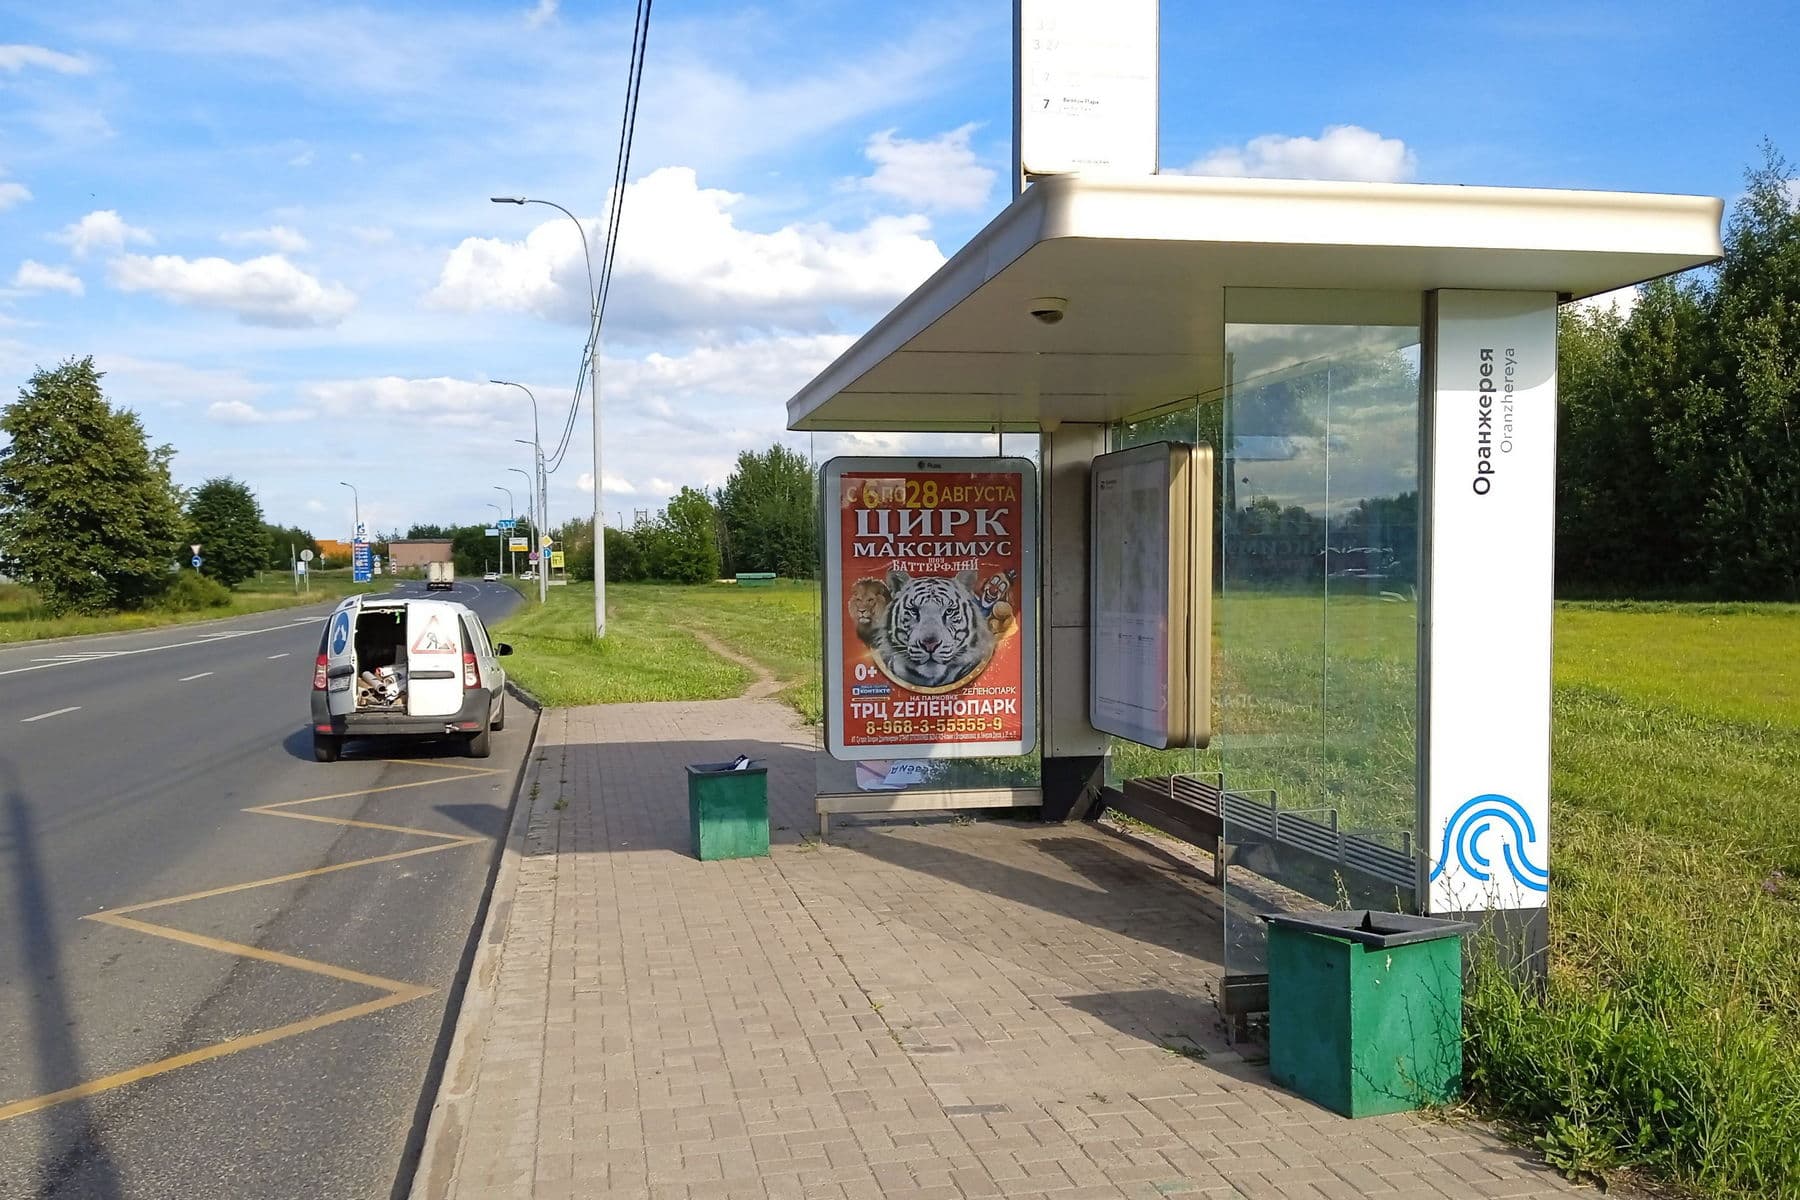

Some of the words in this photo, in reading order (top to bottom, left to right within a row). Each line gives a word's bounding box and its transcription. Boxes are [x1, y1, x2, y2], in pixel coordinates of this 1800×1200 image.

[1500, 347, 1517, 453] Oranzhereya
[1473, 348, 1496, 495] Оранжерея
[906, 480, 939, 509] 28
[940, 486, 1016, 503] АВГУСТА
[855, 508, 1009, 543] ЦИРК
[853, 541, 1012, 557] МАКСИМУС
[854, 663, 878, 681] 0+
[922, 694, 959, 702] ПАРКОВКЕ
[850, 702, 887, 720] ТРЦ
[866, 716, 1003, 735] 8-968-3-55555-9
